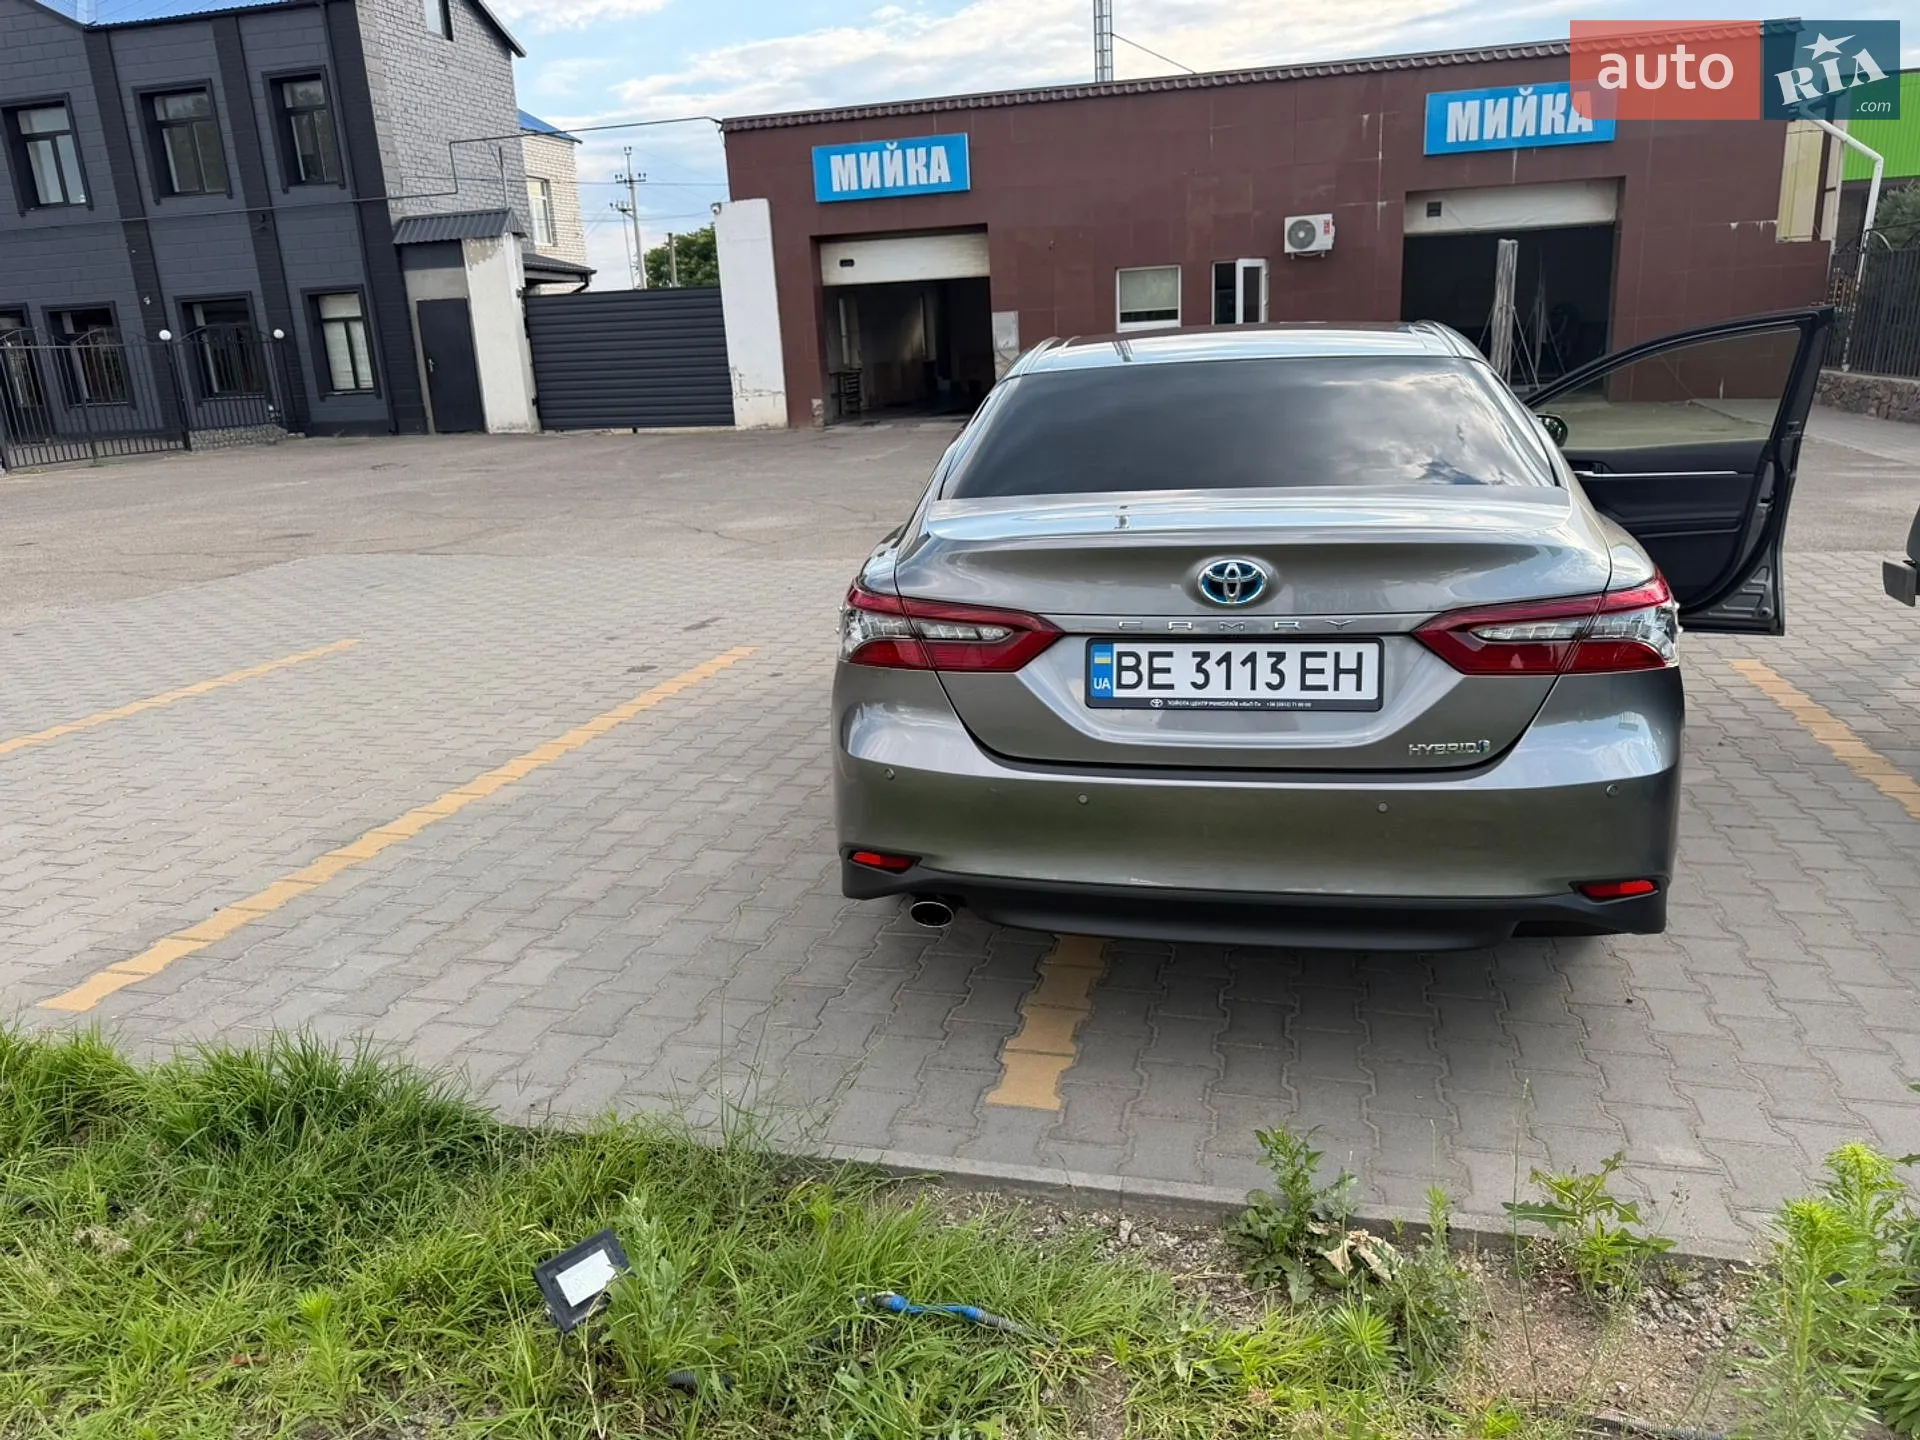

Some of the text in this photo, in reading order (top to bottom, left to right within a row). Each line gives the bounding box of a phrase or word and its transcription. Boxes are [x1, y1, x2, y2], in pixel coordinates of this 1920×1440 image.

[1446, 87, 1593, 143] МИЙКА
[830, 142, 951, 192] МИЙКА
[1118, 620, 1356, 631] CAMRY
[1093, 676, 1111, 690] UA
[1116, 651, 1363, 691] BE 3113 EH
[1408, 743, 1477, 755] HYBRID
